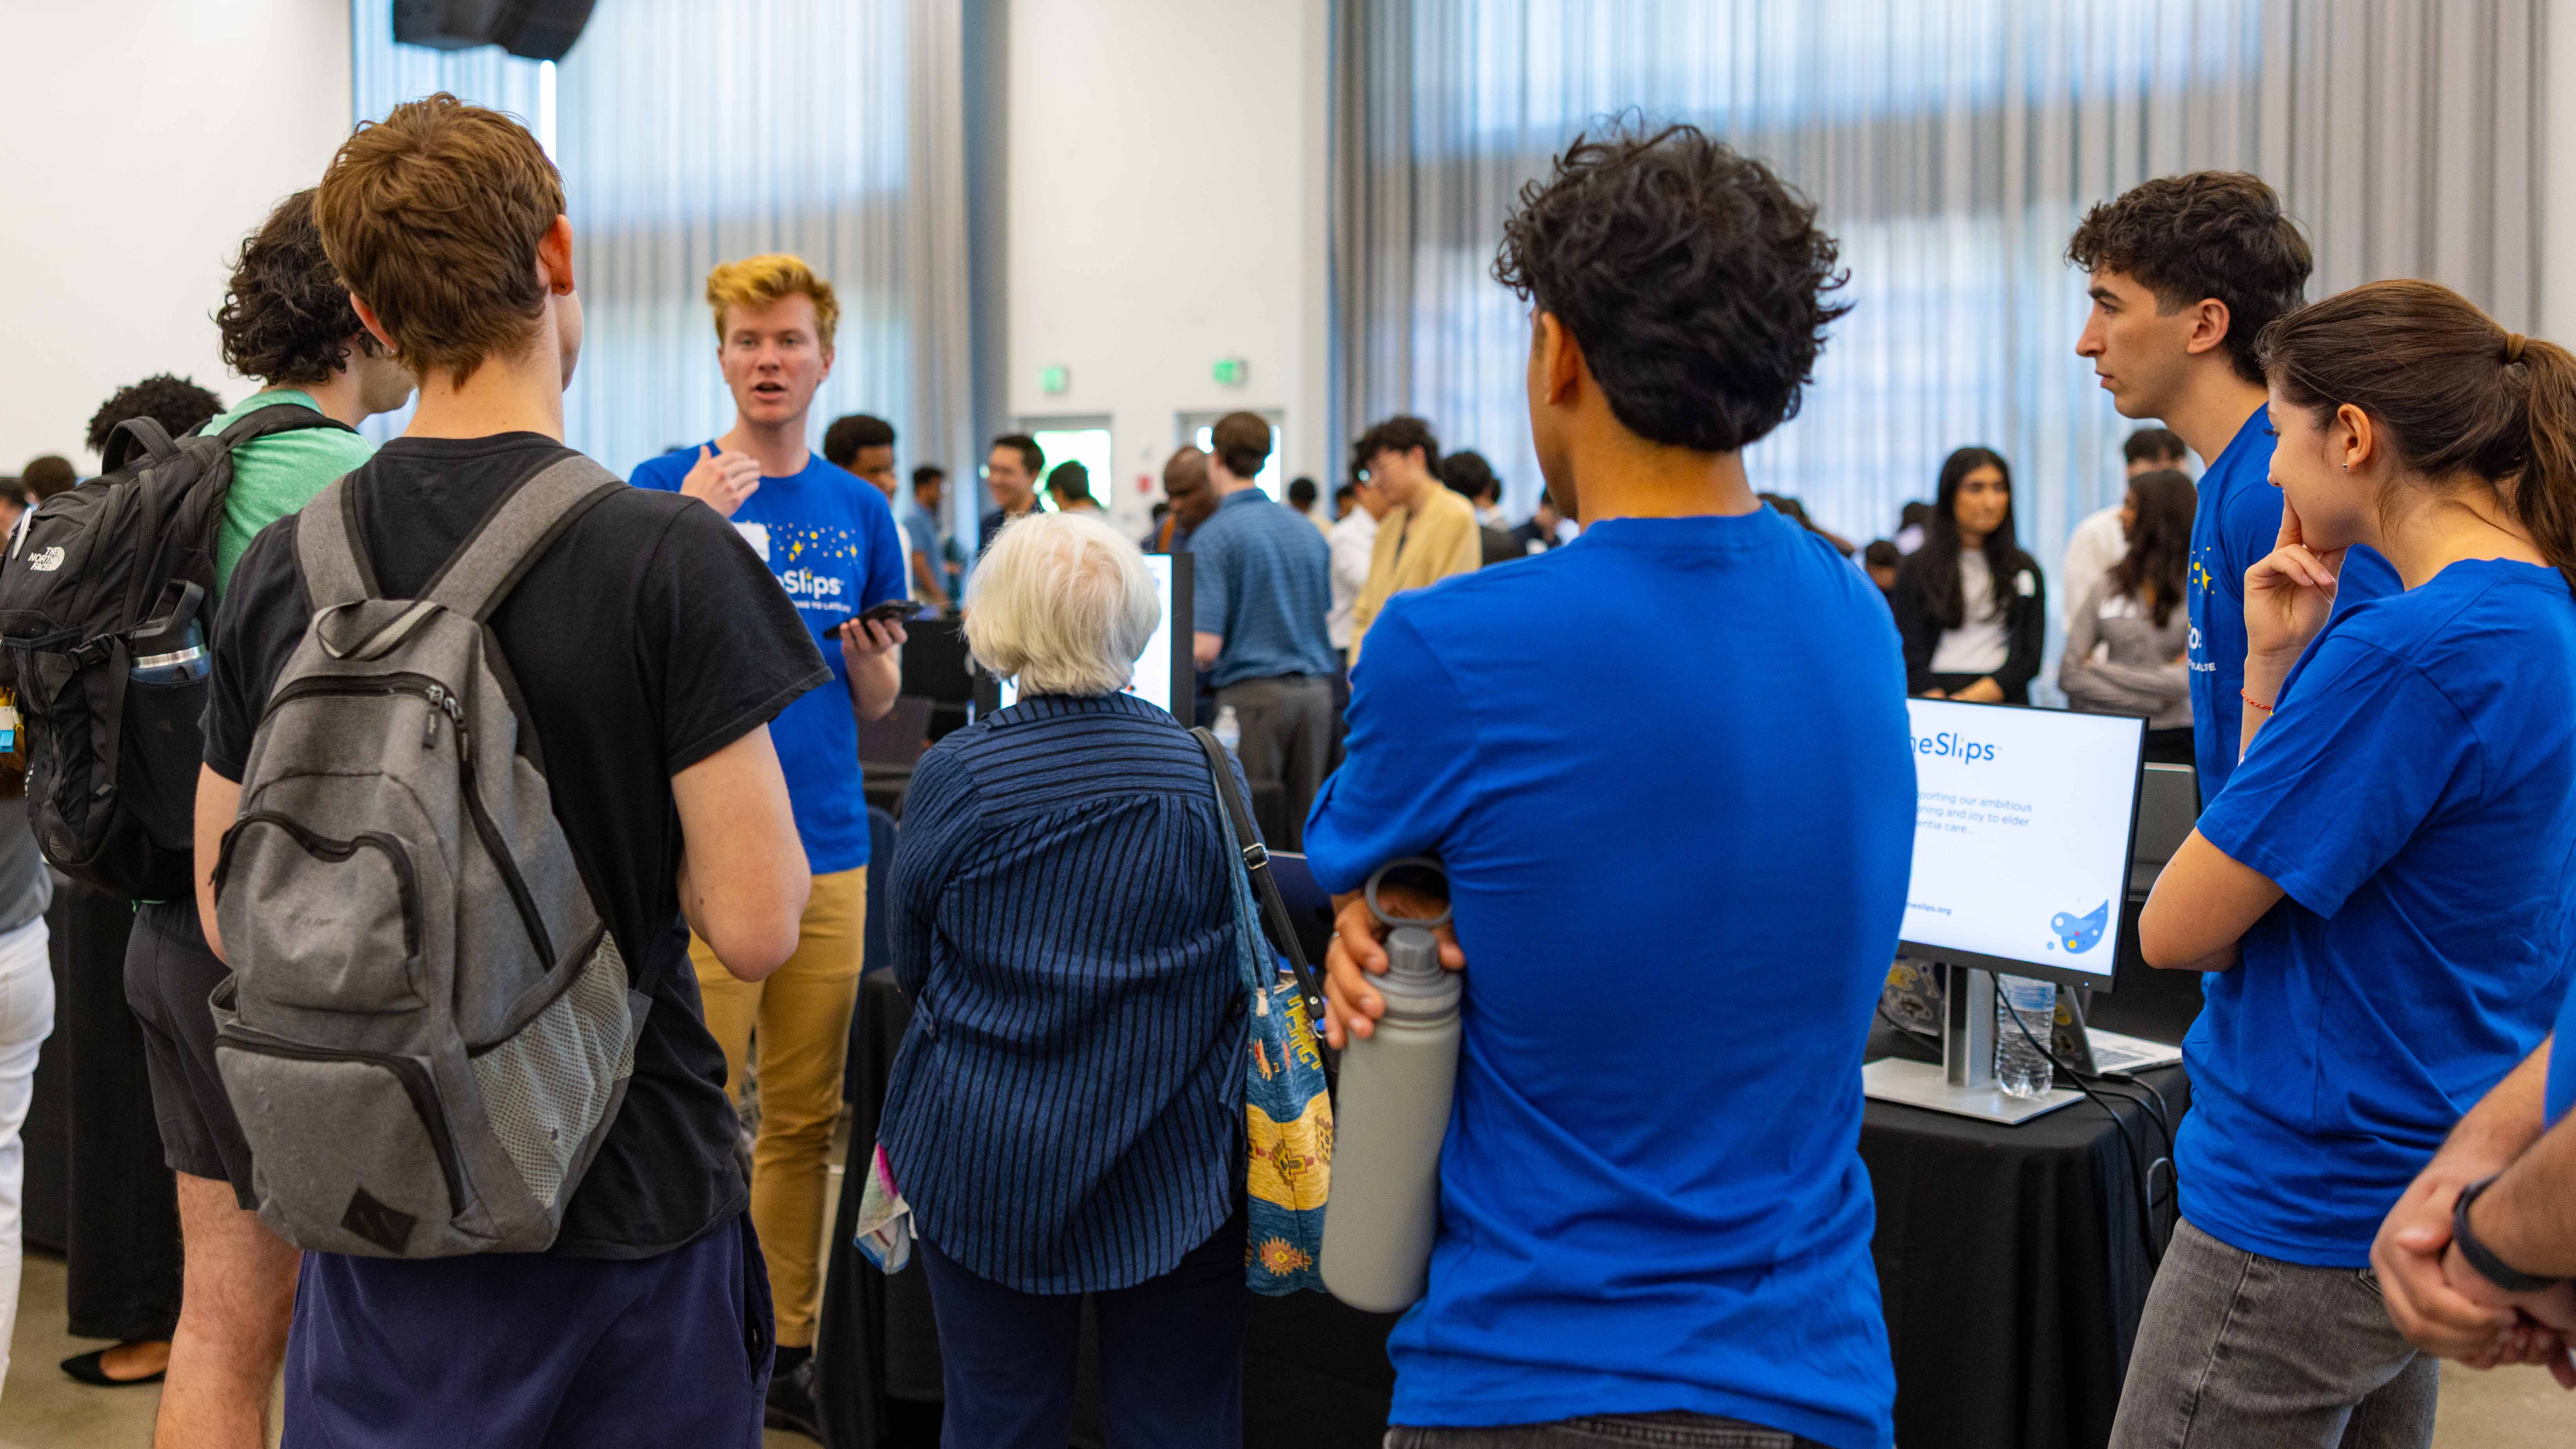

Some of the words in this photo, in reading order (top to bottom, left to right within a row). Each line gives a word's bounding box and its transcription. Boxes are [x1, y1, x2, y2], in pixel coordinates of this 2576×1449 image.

[776, 568, 841, 600] Slips
[1960, 796, 1977, 805] our
[1979, 799, 2032, 812] ambitious
[1916, 805, 1944, 817] aning
[1947, 808, 1967, 819] and
[1969, 812, 1985, 823] joy
[1988, 813, 1999, 823] to
[2002, 815, 2030, 826] elder
[1916, 820, 1942, 830] entia
[1907, 901, 1952, 916] meslips.org
